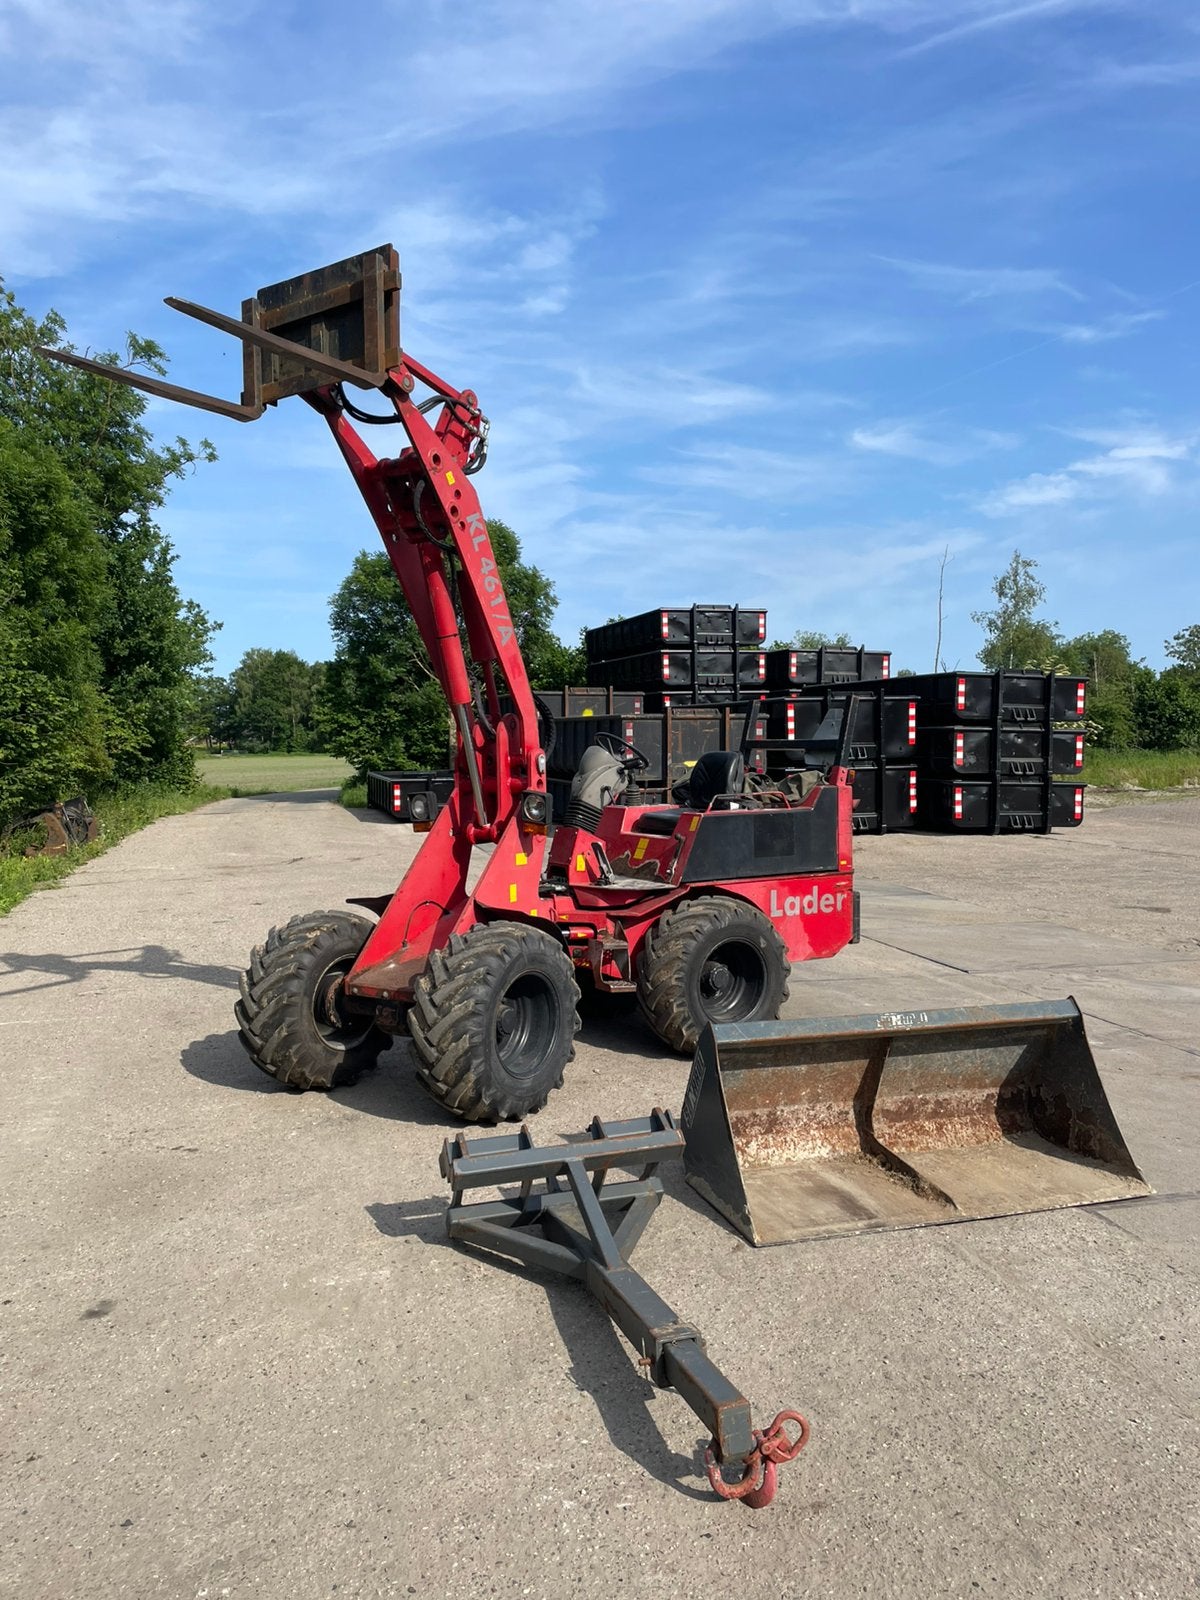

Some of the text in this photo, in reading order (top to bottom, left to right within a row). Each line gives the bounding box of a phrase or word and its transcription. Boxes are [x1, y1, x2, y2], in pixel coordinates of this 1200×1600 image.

[466, 512, 514, 646] KL 461/A
[770, 885, 847, 917] Lader
